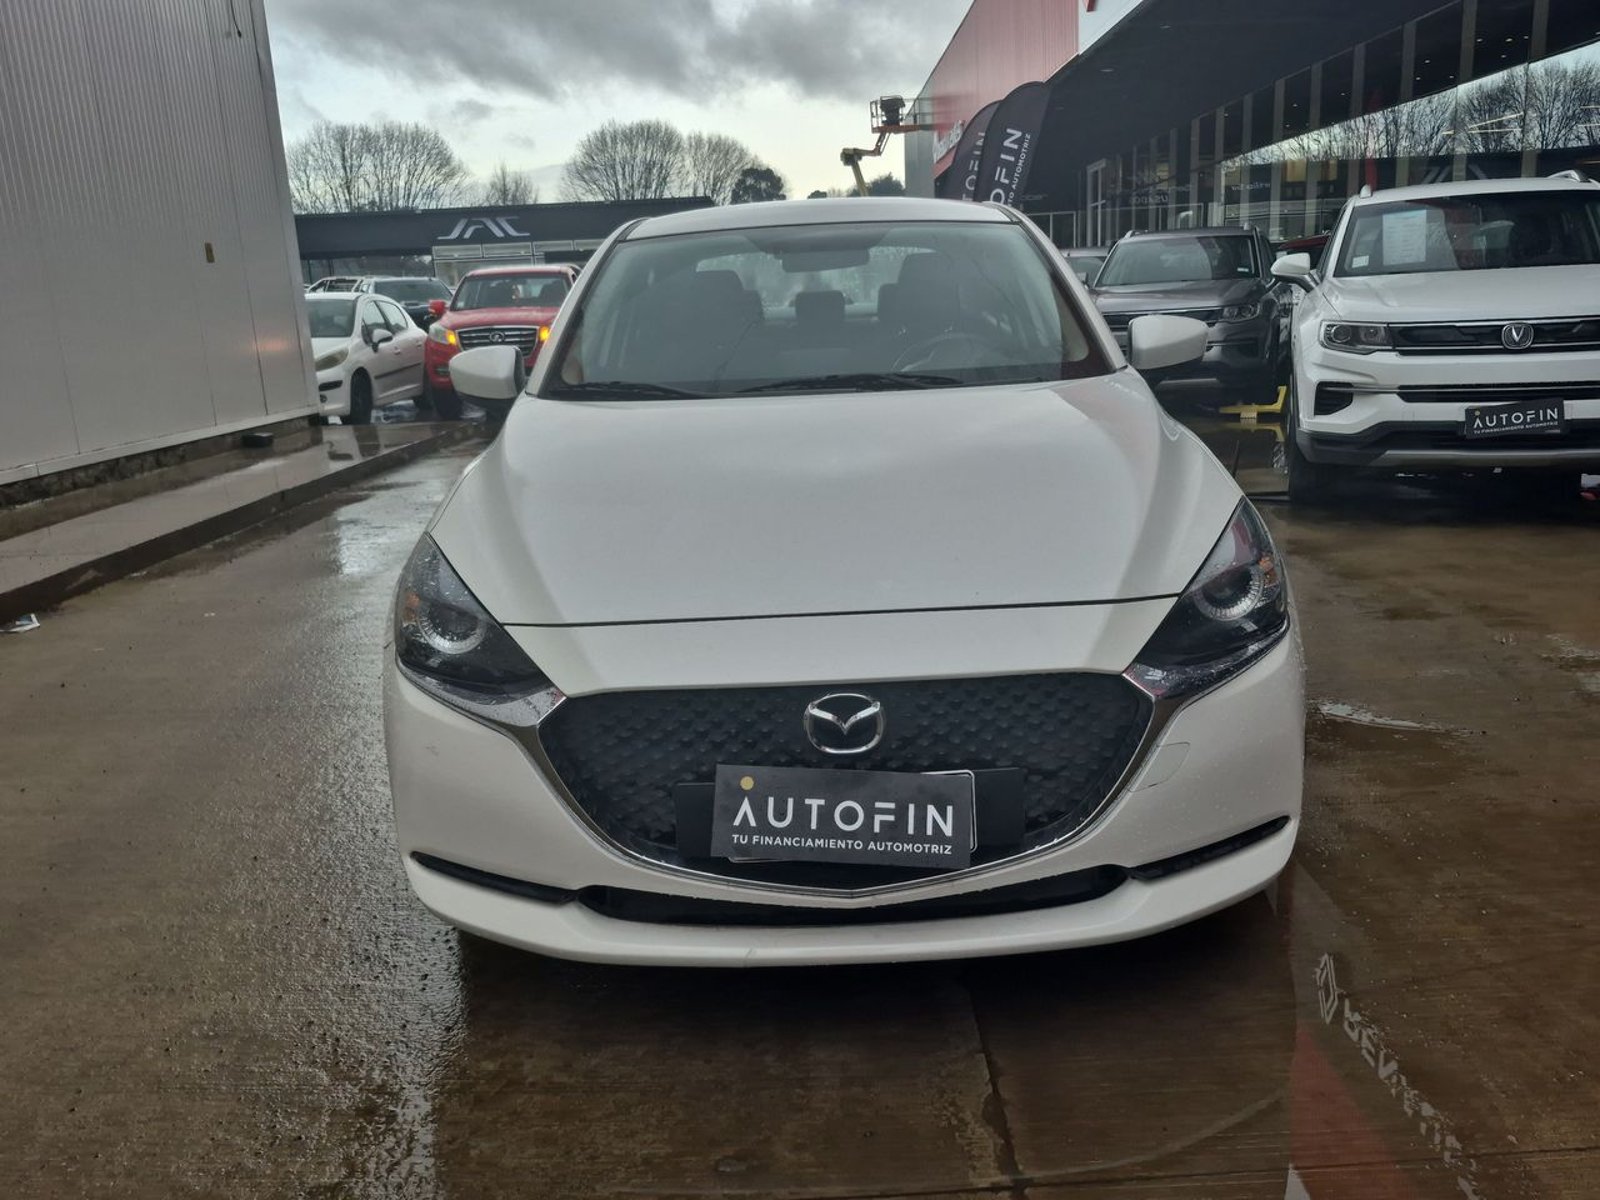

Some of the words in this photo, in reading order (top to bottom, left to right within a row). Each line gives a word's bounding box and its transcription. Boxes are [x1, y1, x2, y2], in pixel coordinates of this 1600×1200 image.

[1011, 133, 1031, 190] AUTOMOTRIZ
[437, 216, 530, 240] JAC
[1473, 408, 1558, 429] AUTOFIN
[733, 795, 953, 837] AUTOFIN
[732, 834, 749, 844] TU
[752, 835, 863, 850] FINANCIAMIENTO
[867, 841, 952, 855] AUTOMOTRIZ
